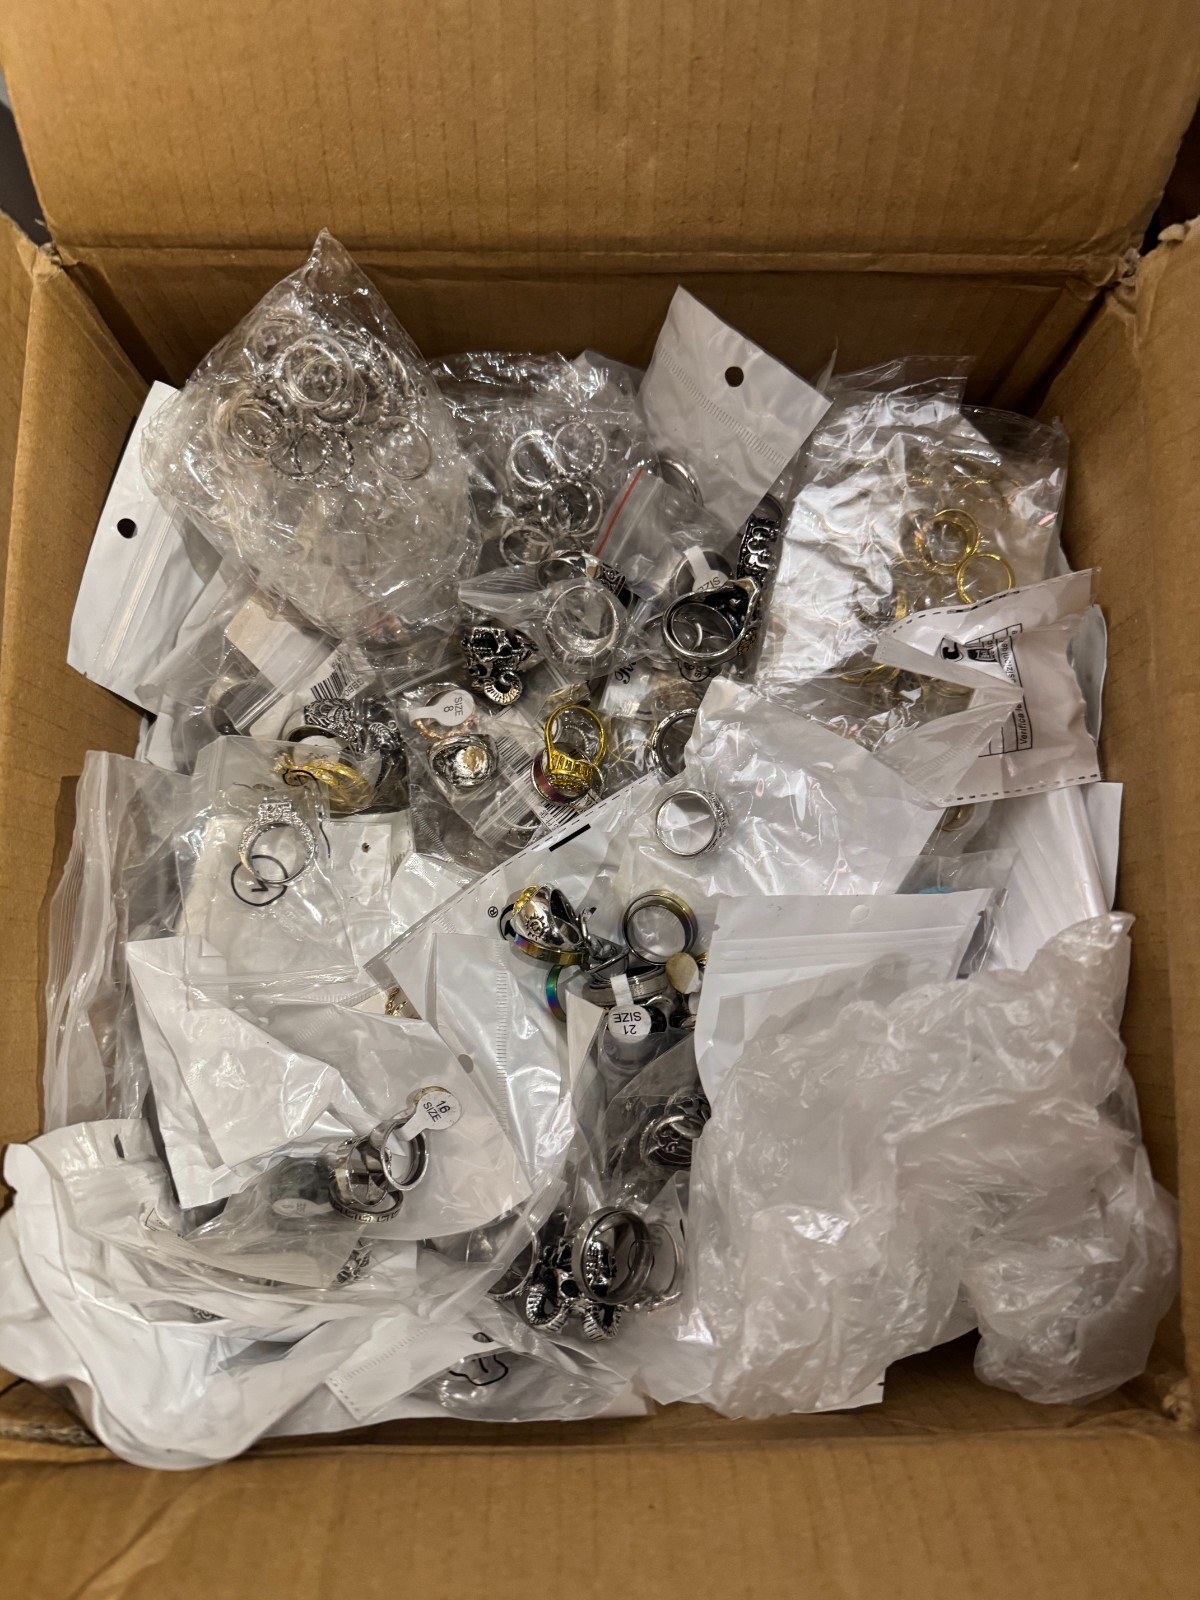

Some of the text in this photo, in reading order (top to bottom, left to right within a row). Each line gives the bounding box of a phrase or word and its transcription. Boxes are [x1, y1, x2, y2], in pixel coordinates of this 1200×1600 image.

[443, 705, 454, 713] 8
[454, 696, 464, 717] SIZE
[612, 1011, 642, 1024] SIZE
[623, 1024, 638, 1035] 21
[423, 1101, 442, 1122] SIZE
[435, 1100, 451, 1114] 16
